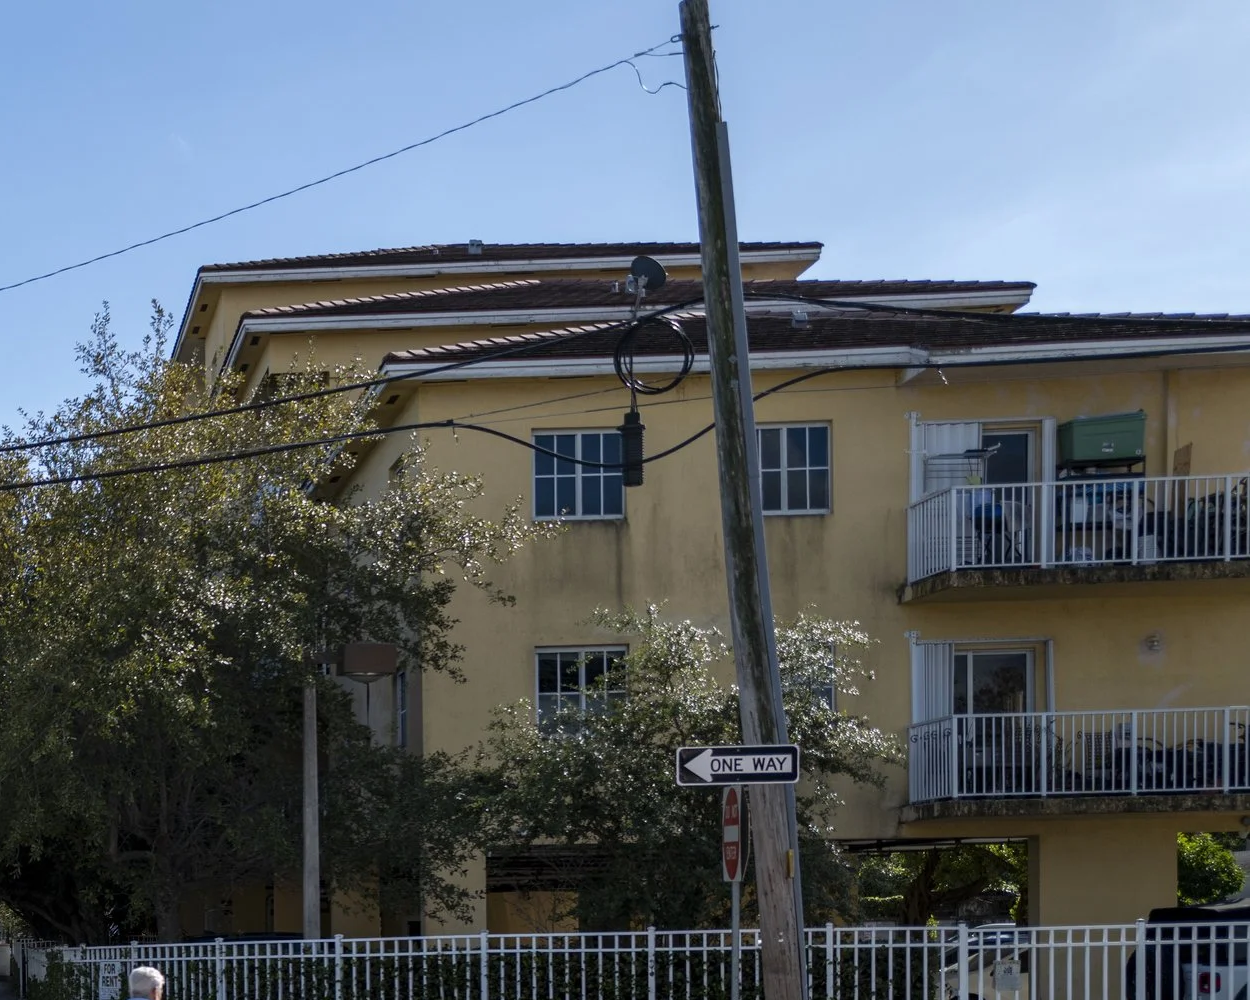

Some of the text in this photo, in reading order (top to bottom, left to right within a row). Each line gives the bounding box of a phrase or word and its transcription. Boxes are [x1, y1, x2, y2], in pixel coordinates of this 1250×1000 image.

[710, 757, 787, 772] ONE WAY
[103, 963, 115, 974] FOR
[102, 975, 118, 987] RENT
